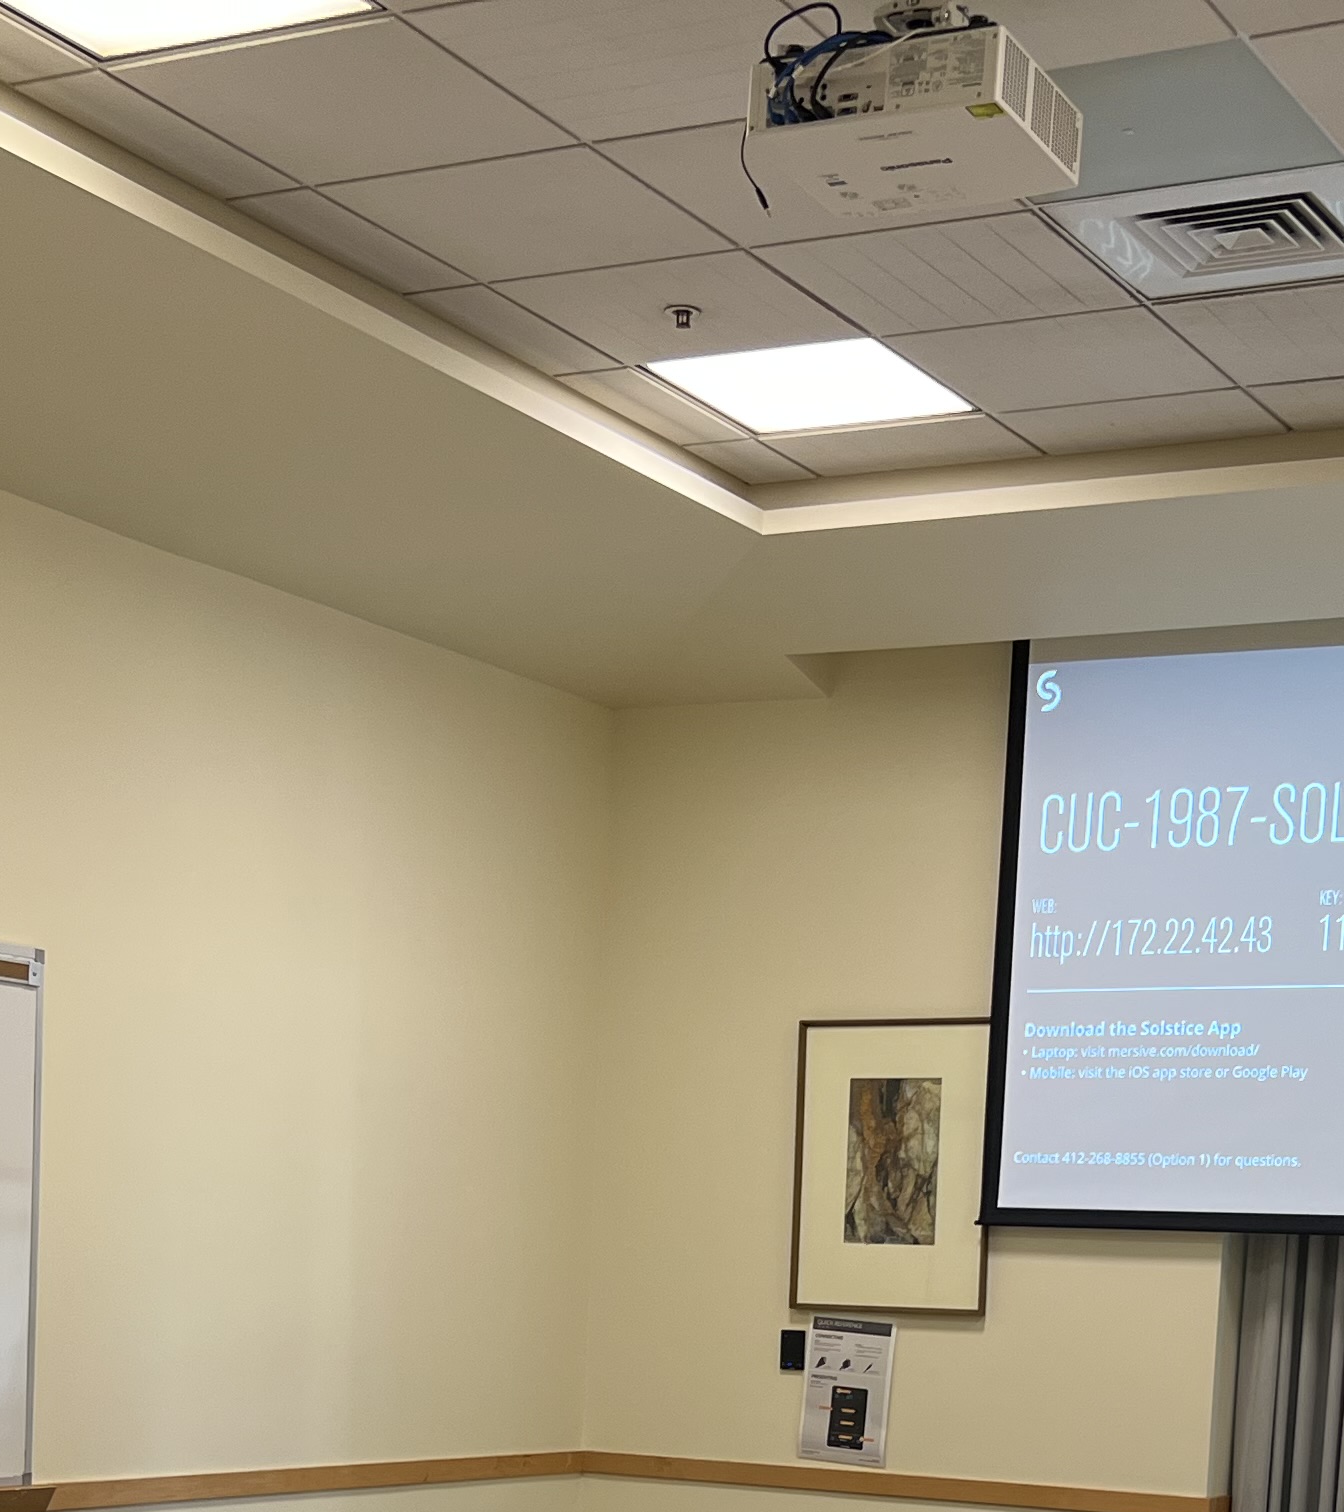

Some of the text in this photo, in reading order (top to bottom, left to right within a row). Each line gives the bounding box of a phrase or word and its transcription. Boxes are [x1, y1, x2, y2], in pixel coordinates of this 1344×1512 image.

[1319, 889, 1343, 906] KEY:
[1029, 916, 1273, 965] http://172.22.42.43
[1024, 1020, 1242, 1039] Download the Solstice App
[1031, 1043, 1261, 1061] Laptop: visit mersive.com/download/
[1029, 1064, 1309, 1082] Mobile: visit the iOS app store or Google Play
[1013, 1150, 1302, 1170] Contact 412-268-8855 (Option 1) for questions.
